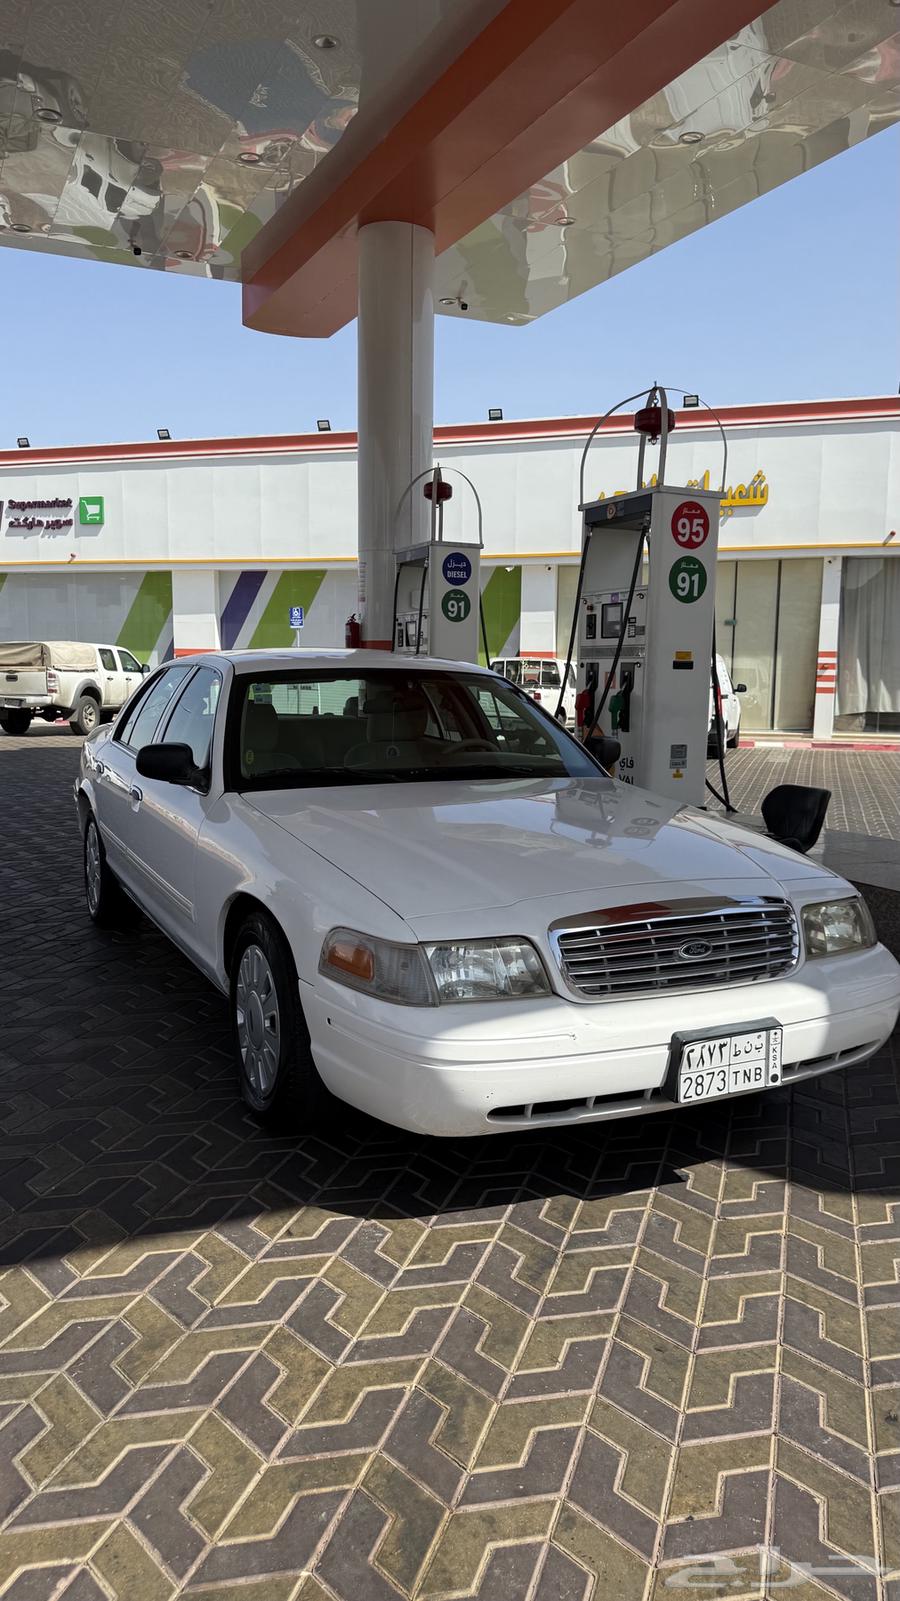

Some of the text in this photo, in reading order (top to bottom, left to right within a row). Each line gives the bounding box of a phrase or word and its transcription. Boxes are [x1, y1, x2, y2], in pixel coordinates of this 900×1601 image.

[8, 498, 73, 511] Supermarket
[677, 517, 705, 543] 95
[447, 559, 467, 569] ديزل
[447, 570, 468, 579] DIESEL
[676, 571, 700, 597] 91
[447, 600, 465, 618] 91
[682, 1067, 763, 1100] 2873 TNB
